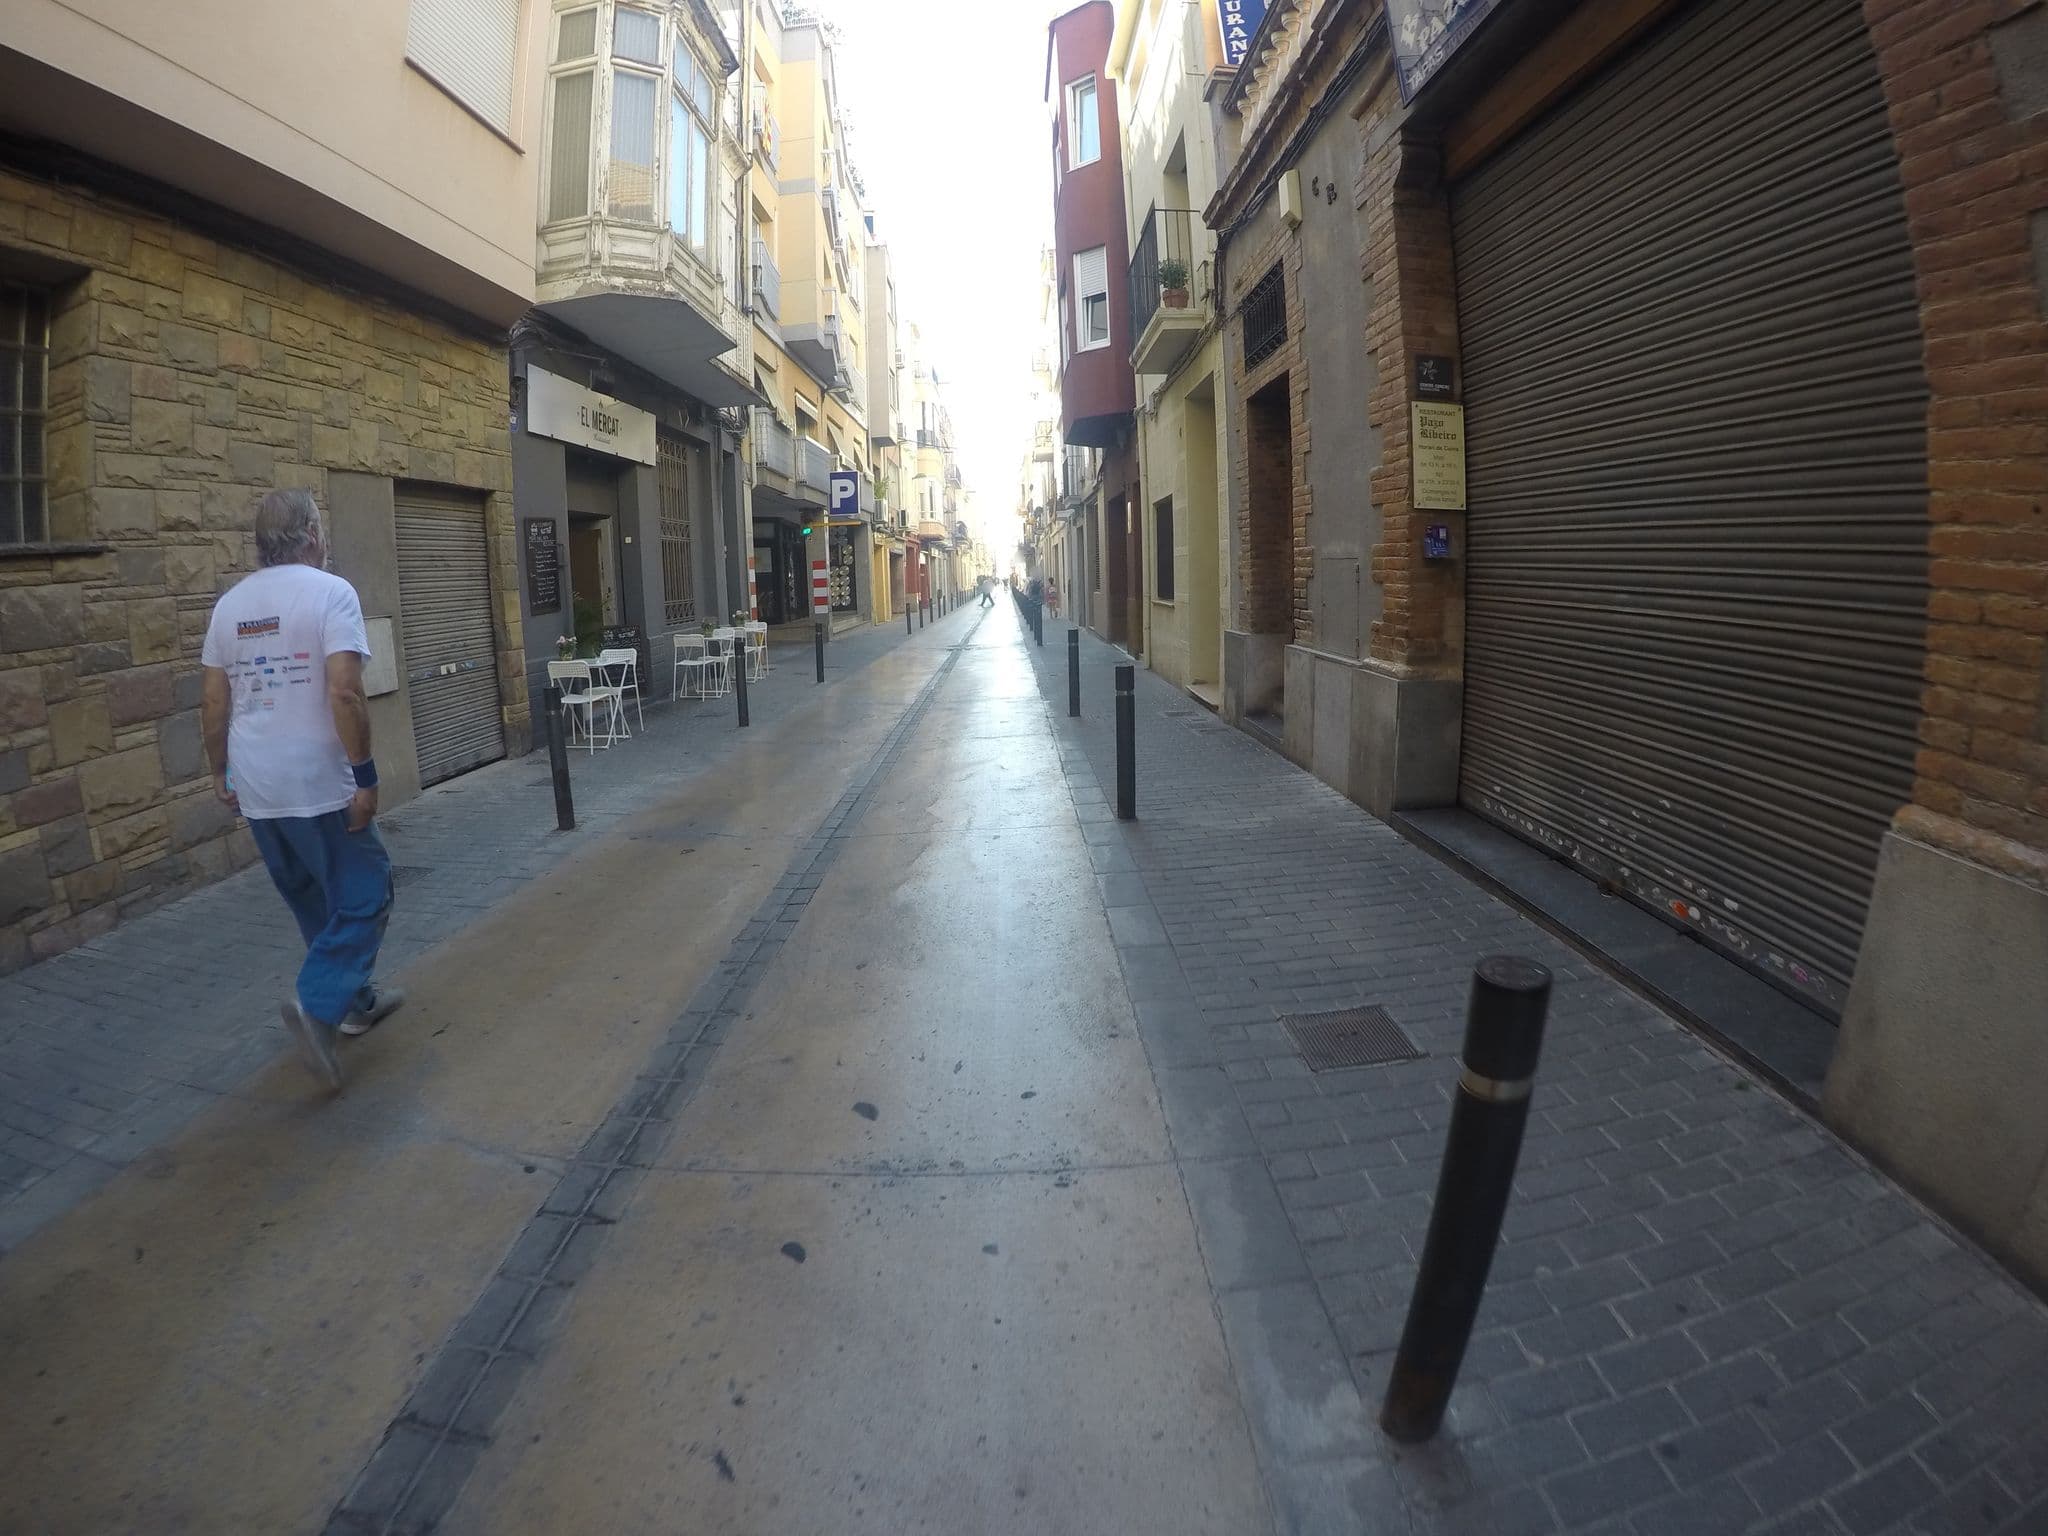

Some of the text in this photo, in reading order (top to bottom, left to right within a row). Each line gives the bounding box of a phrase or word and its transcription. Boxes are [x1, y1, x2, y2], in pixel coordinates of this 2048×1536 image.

[1406, 46, 1443, 90] TAPAS
[581, 405, 620, 438] EL MERCAT
[1419, 428, 1457, 440] Ribeiro
[831, 478, 855, 509] P
